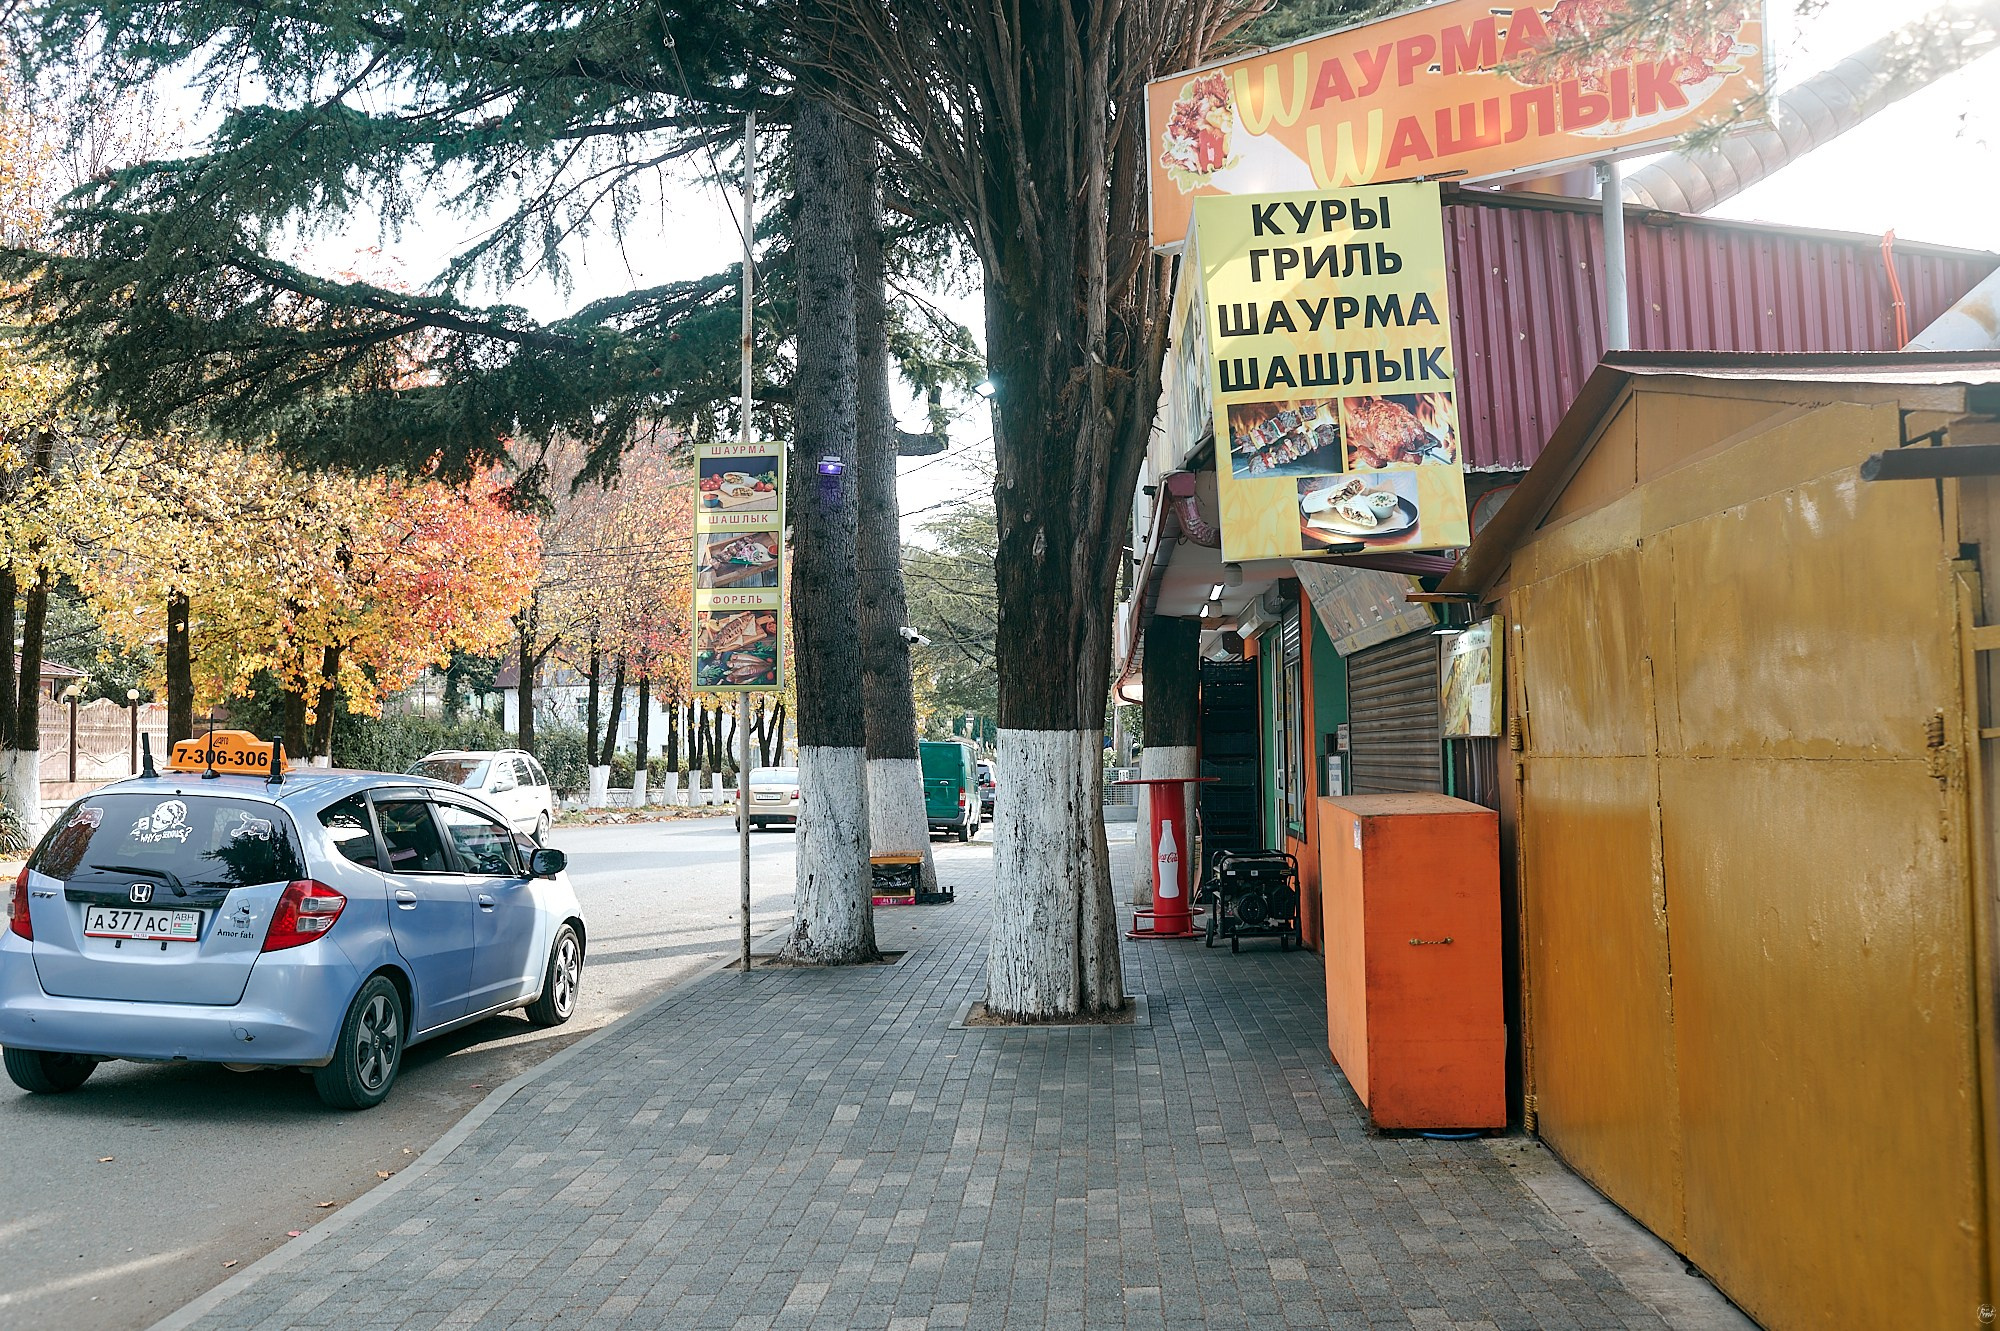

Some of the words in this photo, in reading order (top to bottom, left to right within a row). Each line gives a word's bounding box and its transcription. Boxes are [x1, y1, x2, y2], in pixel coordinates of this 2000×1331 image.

[1252, 196, 1391, 236] КУРЫ
[1250, 242, 1403, 282] ГРИЛЬ
[1218, 292, 1440, 337] ШАУРМА
[1219, 346, 1450, 392] ШАШЛЫК
[711, 445, 766, 455] ШАУРМА
[708, 514, 768, 524] ШАШЛЫК
[712, 595, 763, 604] ФОРЕЛЬ
[177, 748, 268, 767] 7-306-306
[93, 910, 169, 932] A377AC
[175, 913, 194, 921] ABH
[217, 928, 239, 938] Amor
[240, 930, 254, 939] fati
